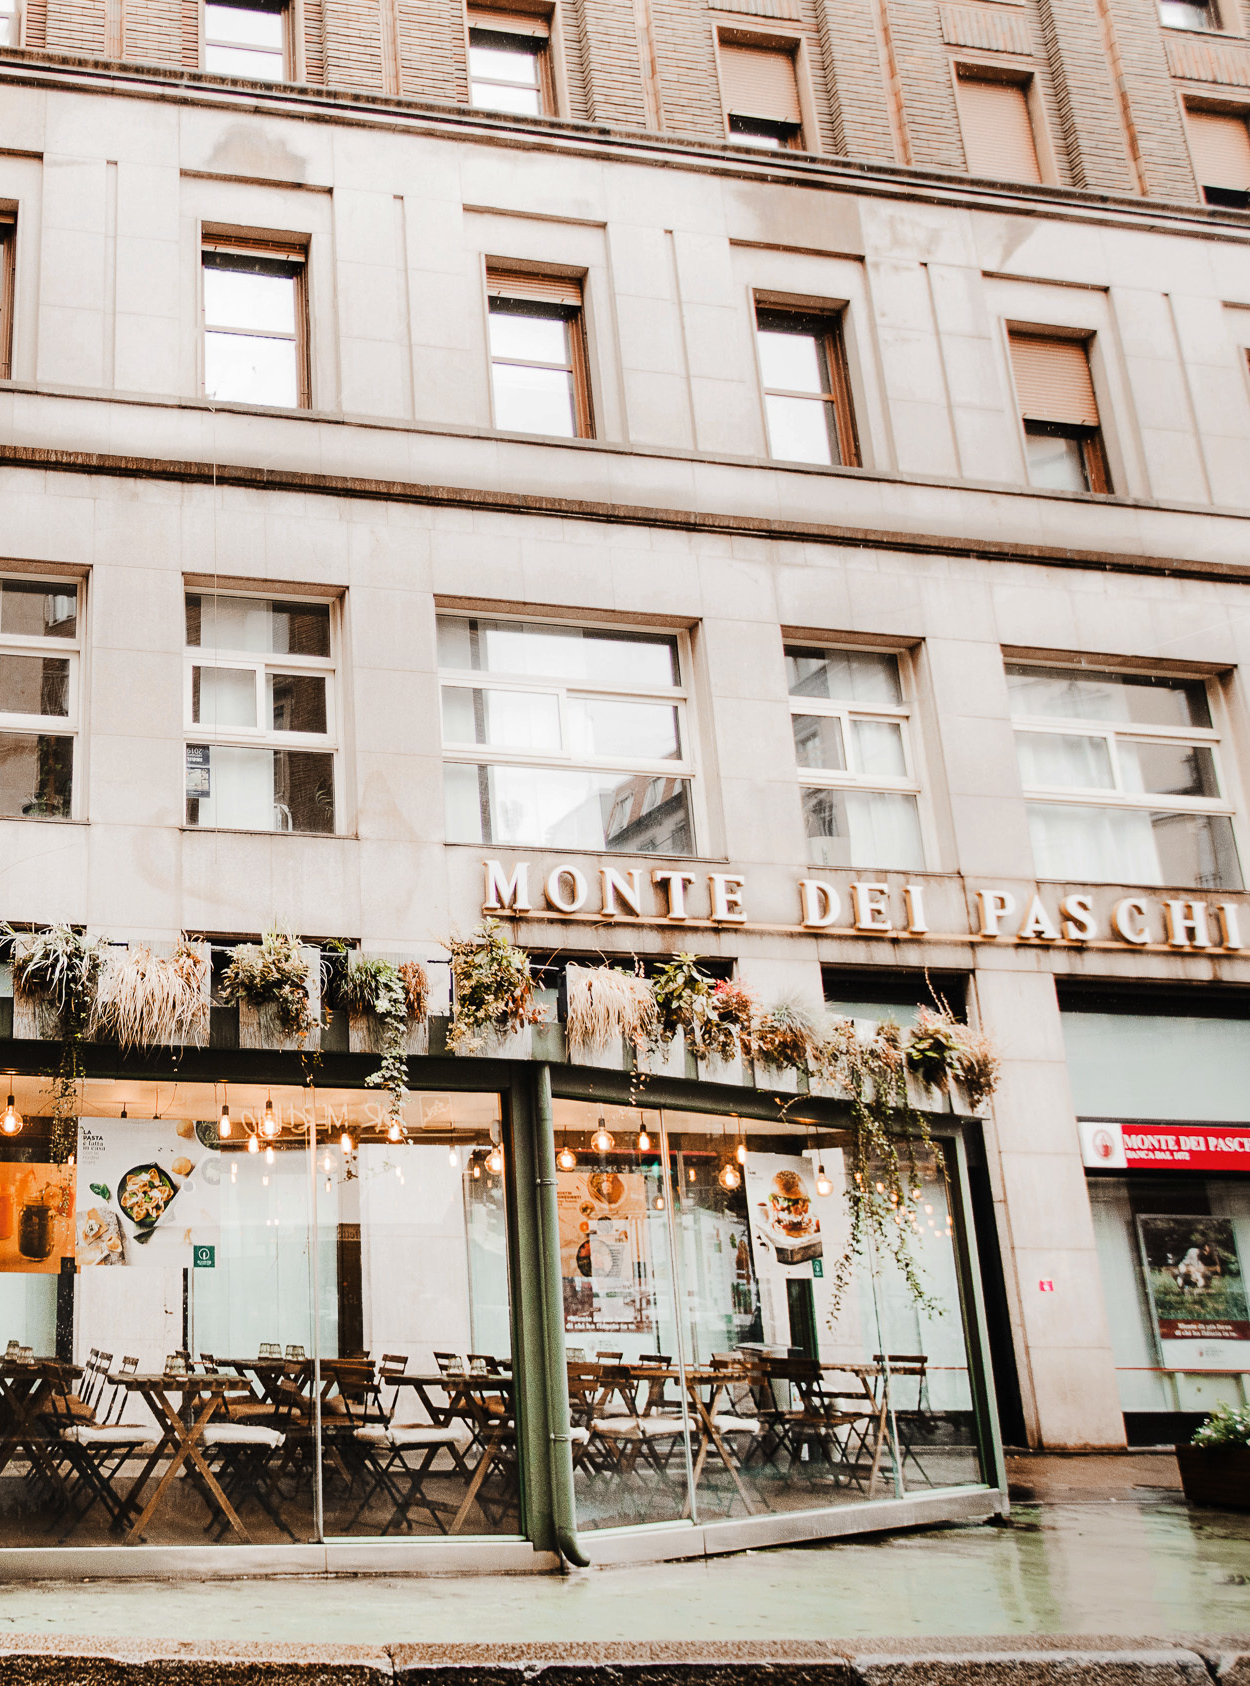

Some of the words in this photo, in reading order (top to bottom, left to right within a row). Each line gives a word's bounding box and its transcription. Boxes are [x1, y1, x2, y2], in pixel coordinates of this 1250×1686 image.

[482, 860, 748, 923] MONTE
[798, 879, 930, 933] DEI
[974, 889, 1241, 949] PASCHI
[1122, 1134, 1178, 1150] MONTE
[1178, 1135, 1207, 1151] DEI
